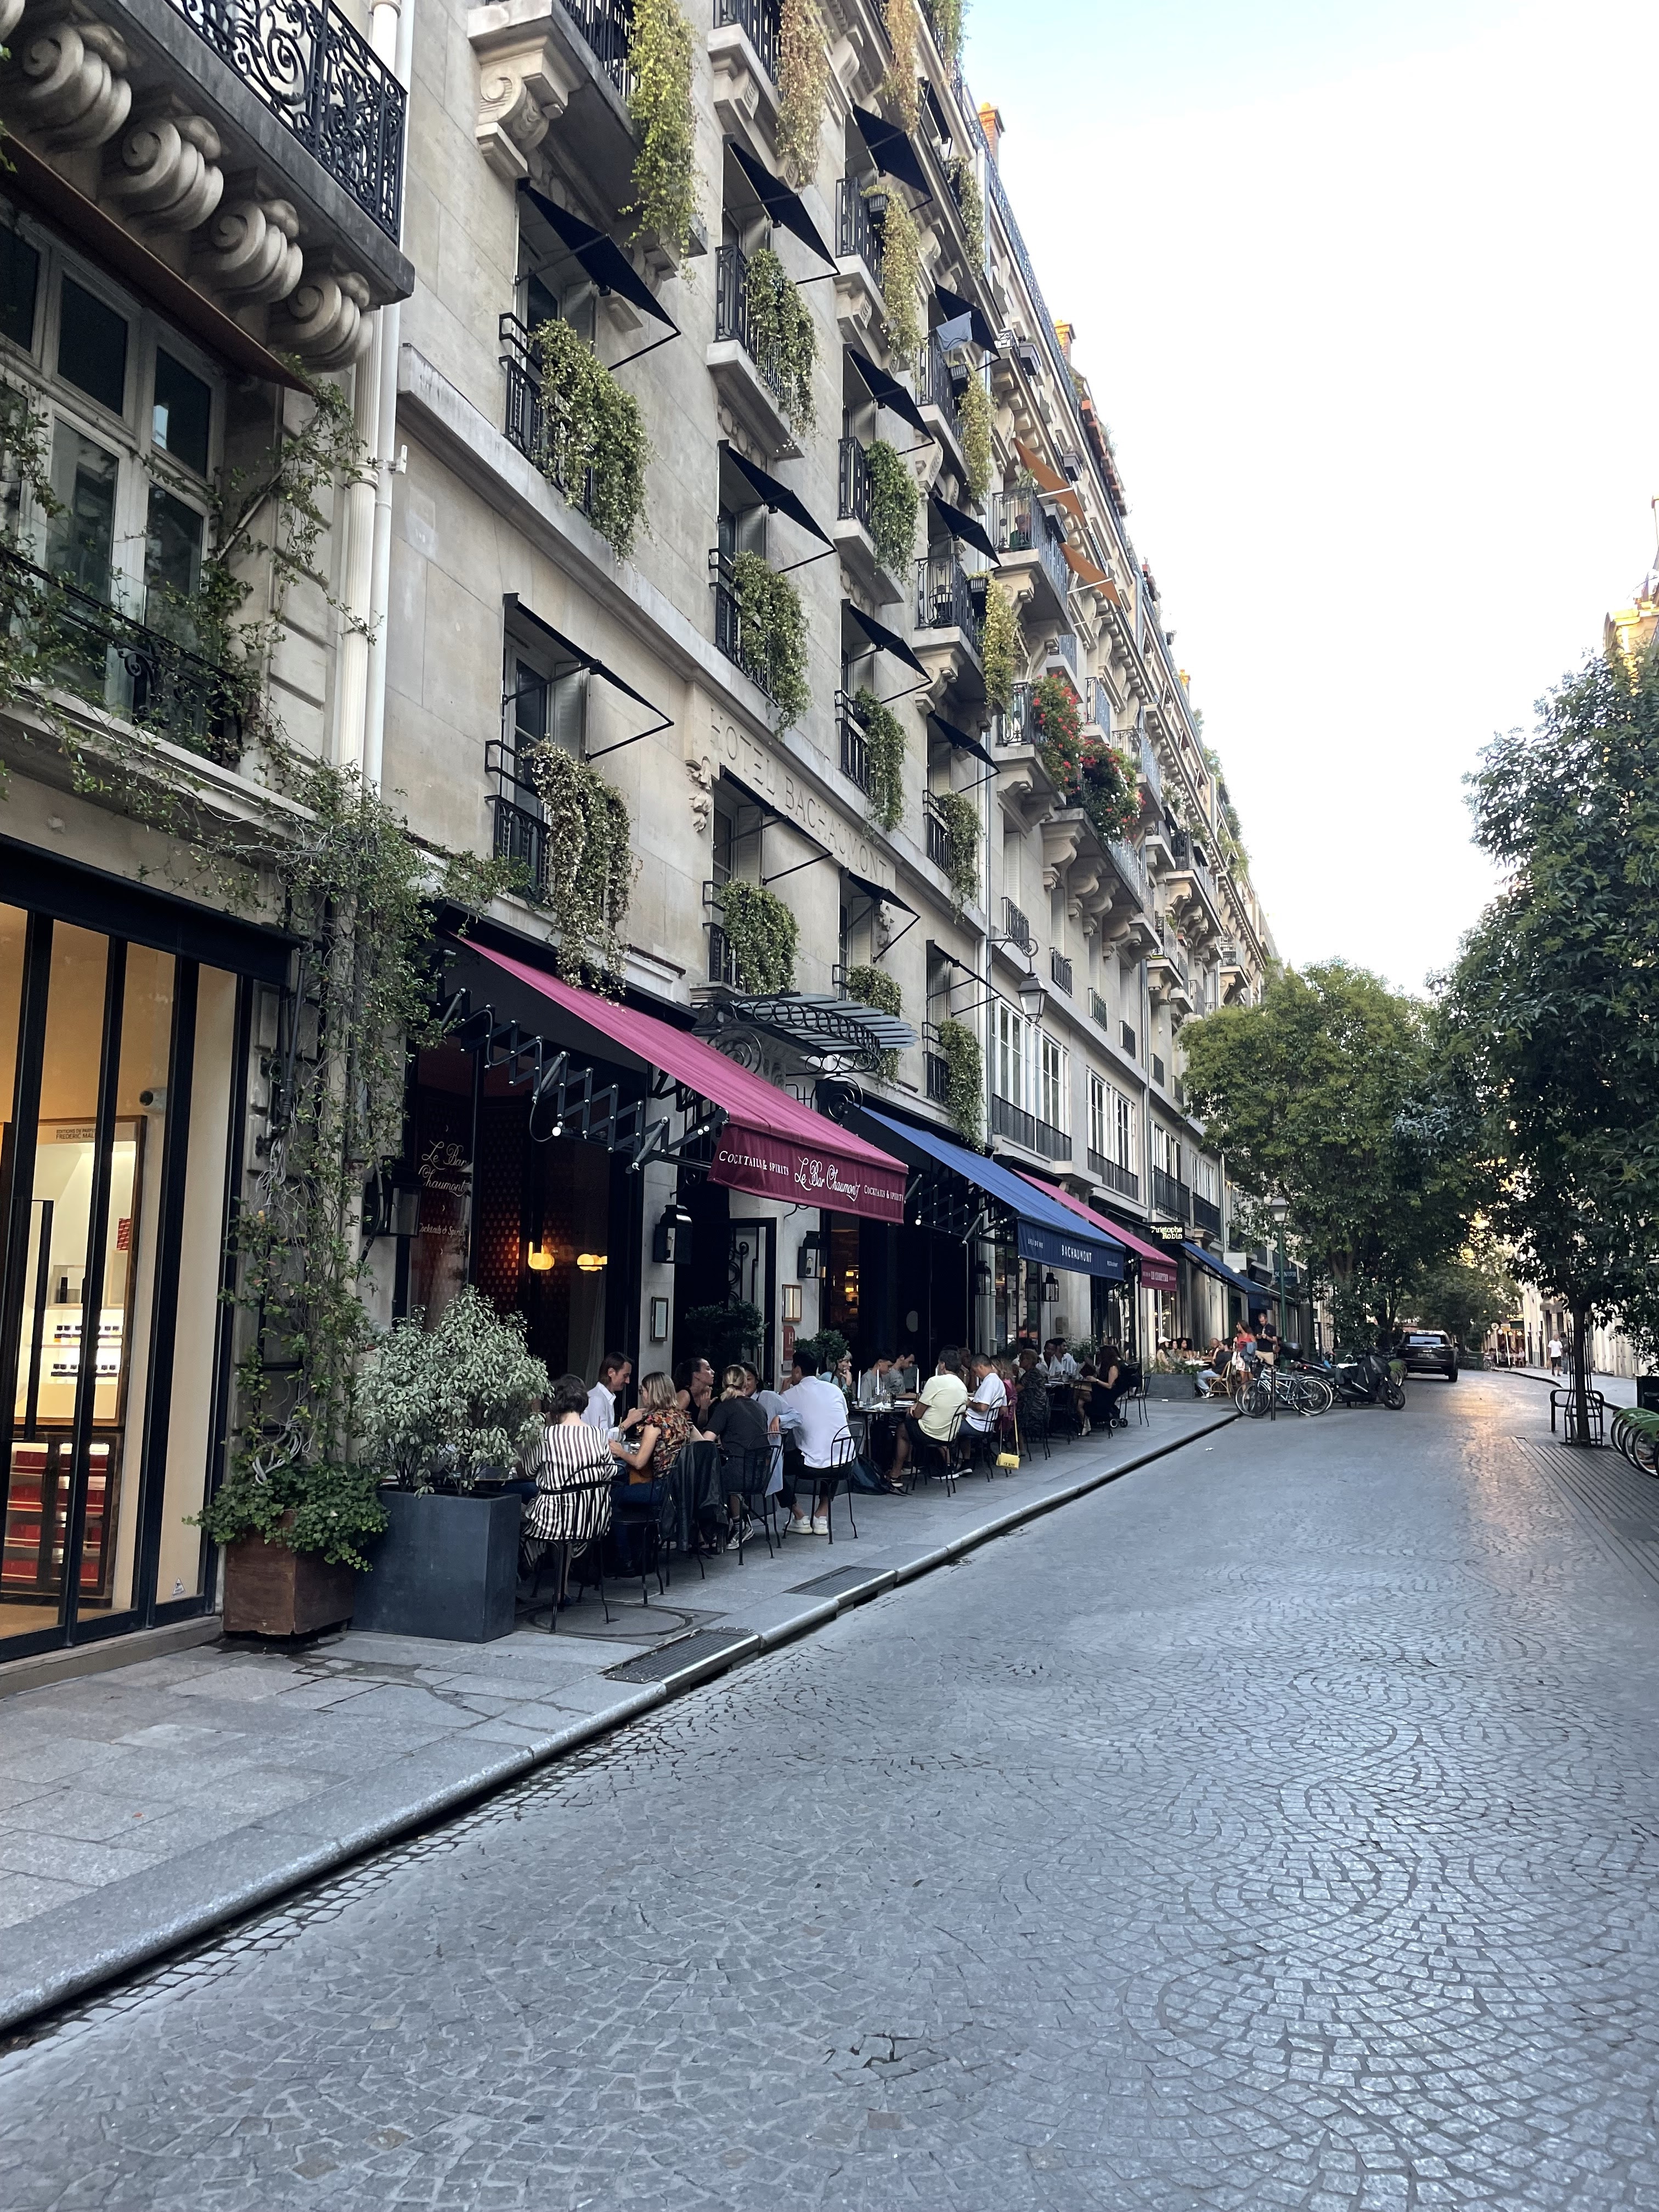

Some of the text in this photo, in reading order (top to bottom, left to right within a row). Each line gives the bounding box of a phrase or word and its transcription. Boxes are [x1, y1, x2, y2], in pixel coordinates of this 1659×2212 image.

[710, 708, 887, 888] HOTEL BACHAUMONT
[421, 1139, 469, 1170] Le Bar
[418, 1164, 470, 1197] Chaumont
[719, 1150, 762, 1169] COCKTAILS
[763, 1159, 768, 1170] &
[769, 1162, 789, 1176] SPIRITS
[794, 1156, 811, 1191] Le
[809, 1159, 825, 1188] Bar
[827, 1164, 861, 1202] Chaumont
[886, 1190, 890, 1199] &
[1062, 1244, 1093, 1263] BACHAUMONT
[788, 1332, 794, 1345] H
